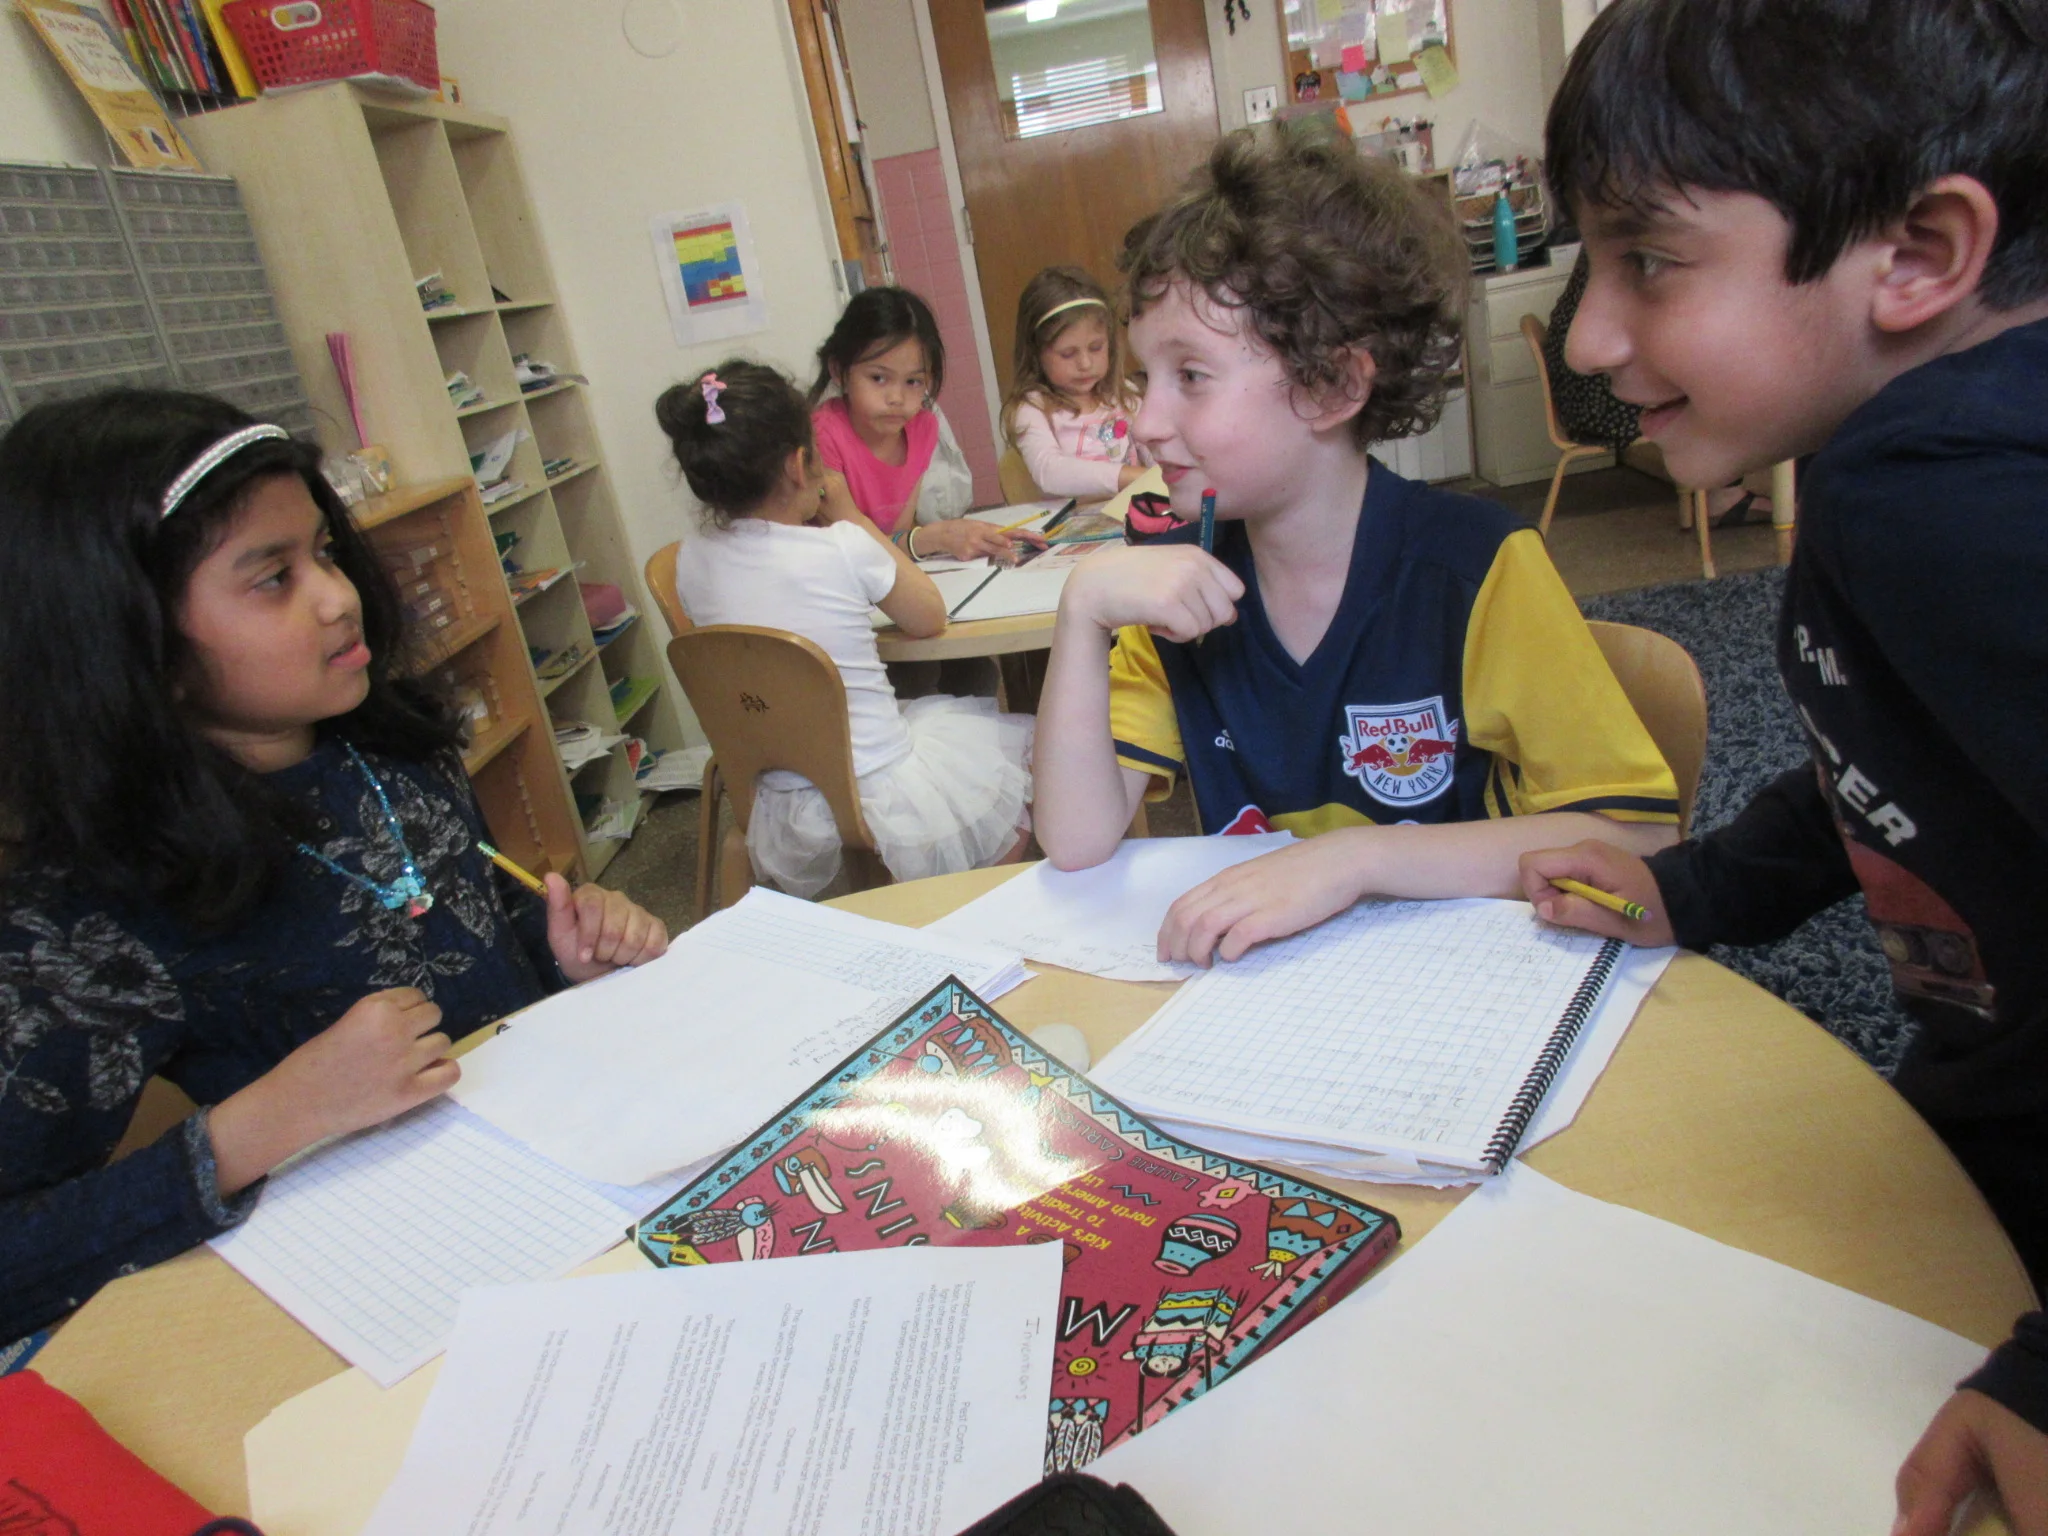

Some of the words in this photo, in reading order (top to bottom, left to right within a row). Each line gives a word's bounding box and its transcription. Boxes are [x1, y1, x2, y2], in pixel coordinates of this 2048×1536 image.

[1357, 719, 1392, 737] Red
[1393, 712, 1434, 734] Bull
[1373, 772, 1402, 795] NEW
[1407, 765, 1444, 794] YORK
[1127, 1156, 1200, 1191] LAURIE
[1015, 1202, 1073, 1233] Activity
[1086, 1215, 1108, 1229] To
[1015, 1225, 1032, 1237] A
[1071, 1227, 1113, 1251] Kid's
